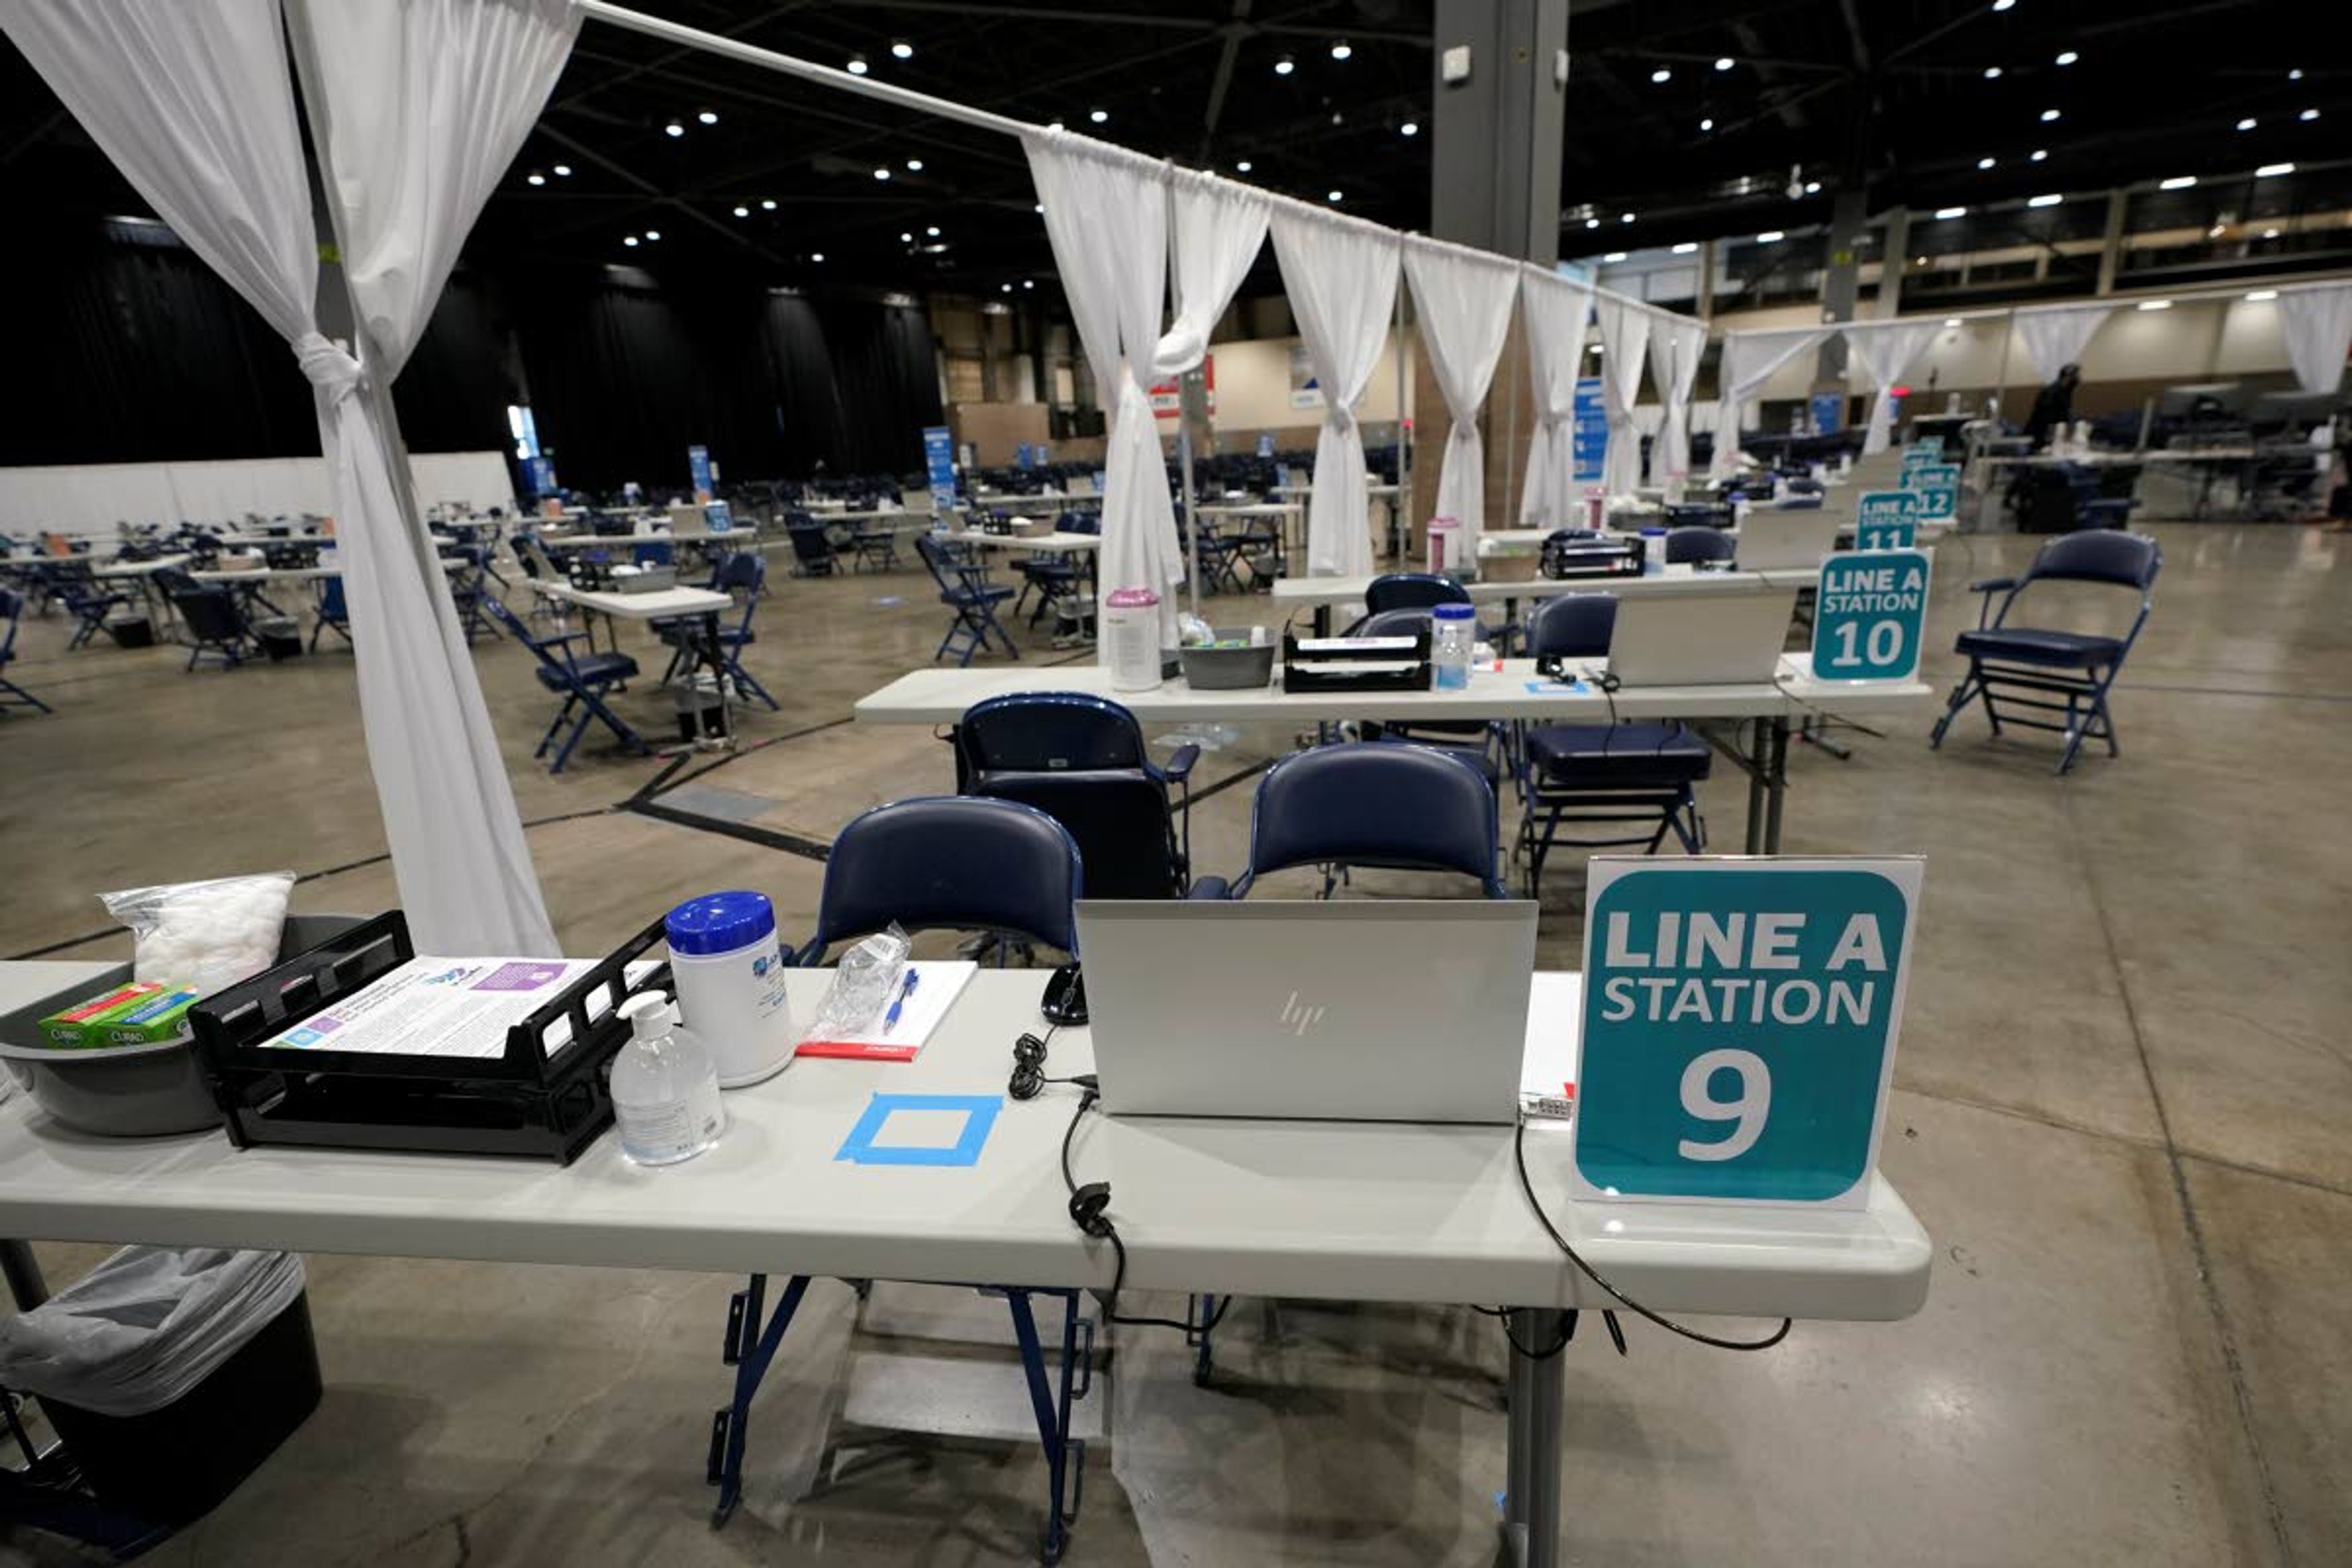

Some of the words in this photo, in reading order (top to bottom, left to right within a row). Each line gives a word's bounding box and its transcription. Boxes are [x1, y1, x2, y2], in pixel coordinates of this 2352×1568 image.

[1863, 500, 1900, 515] LINE
[1903, 500, 1916, 514] A
[1916, 494, 1947, 513] 12
[1861, 514, 1913, 526] STATION
[1867, 530, 1901, 549] 11
[1825, 568, 1896, 593] LINE
[1901, 568, 1922, 591] A
[1824, 594, 1919, 613] STATION
[1831, 619, 1904, 667] 10
[1605, 911, 1806, 970] LINE
[1826, 913, 1888, 971] A
[1601, 976, 1874, 1026] STATION
[1678, 1048, 1772, 1162] 9
